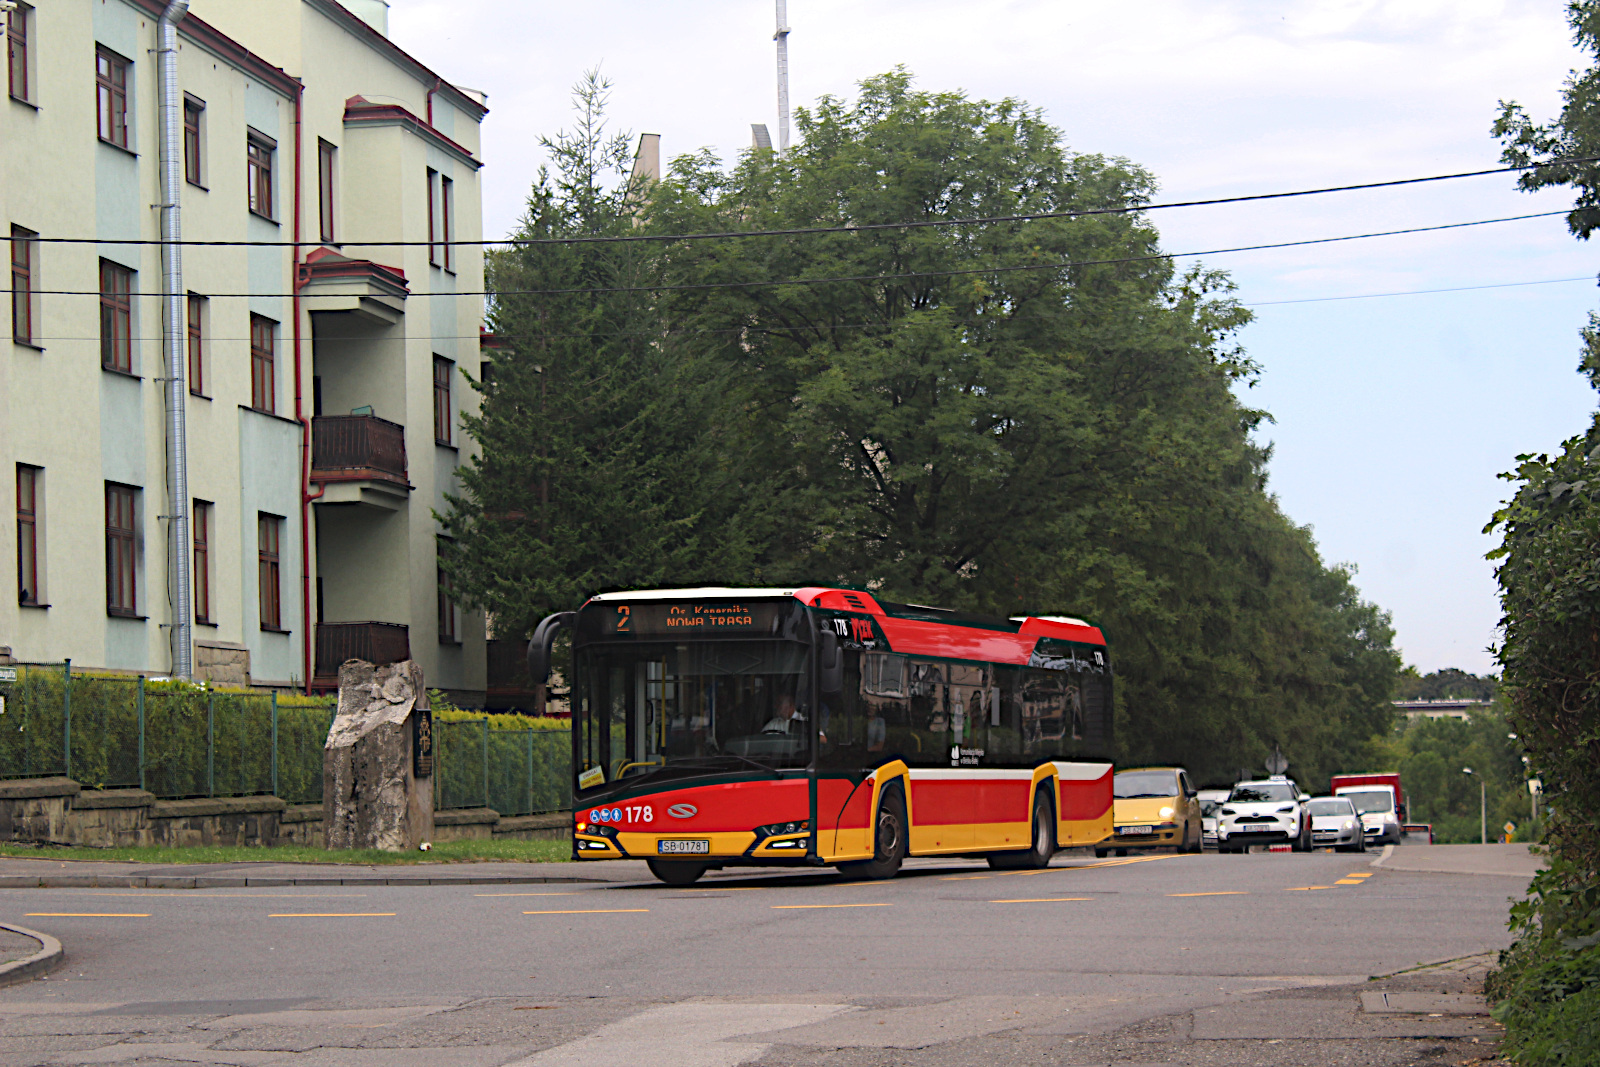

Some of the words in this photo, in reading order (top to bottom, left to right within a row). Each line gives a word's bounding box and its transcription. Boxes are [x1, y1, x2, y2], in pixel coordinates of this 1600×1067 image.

[617, 605, 630, 631] 2
[666, 617, 704, 626] NOWA
[709, 616, 752, 626] TRASA
[833, 618, 848, 636] 178
[625, 805, 654, 823] 178
[663, 842, 677, 851] SB
[679, 841, 708, 851] 0178T
